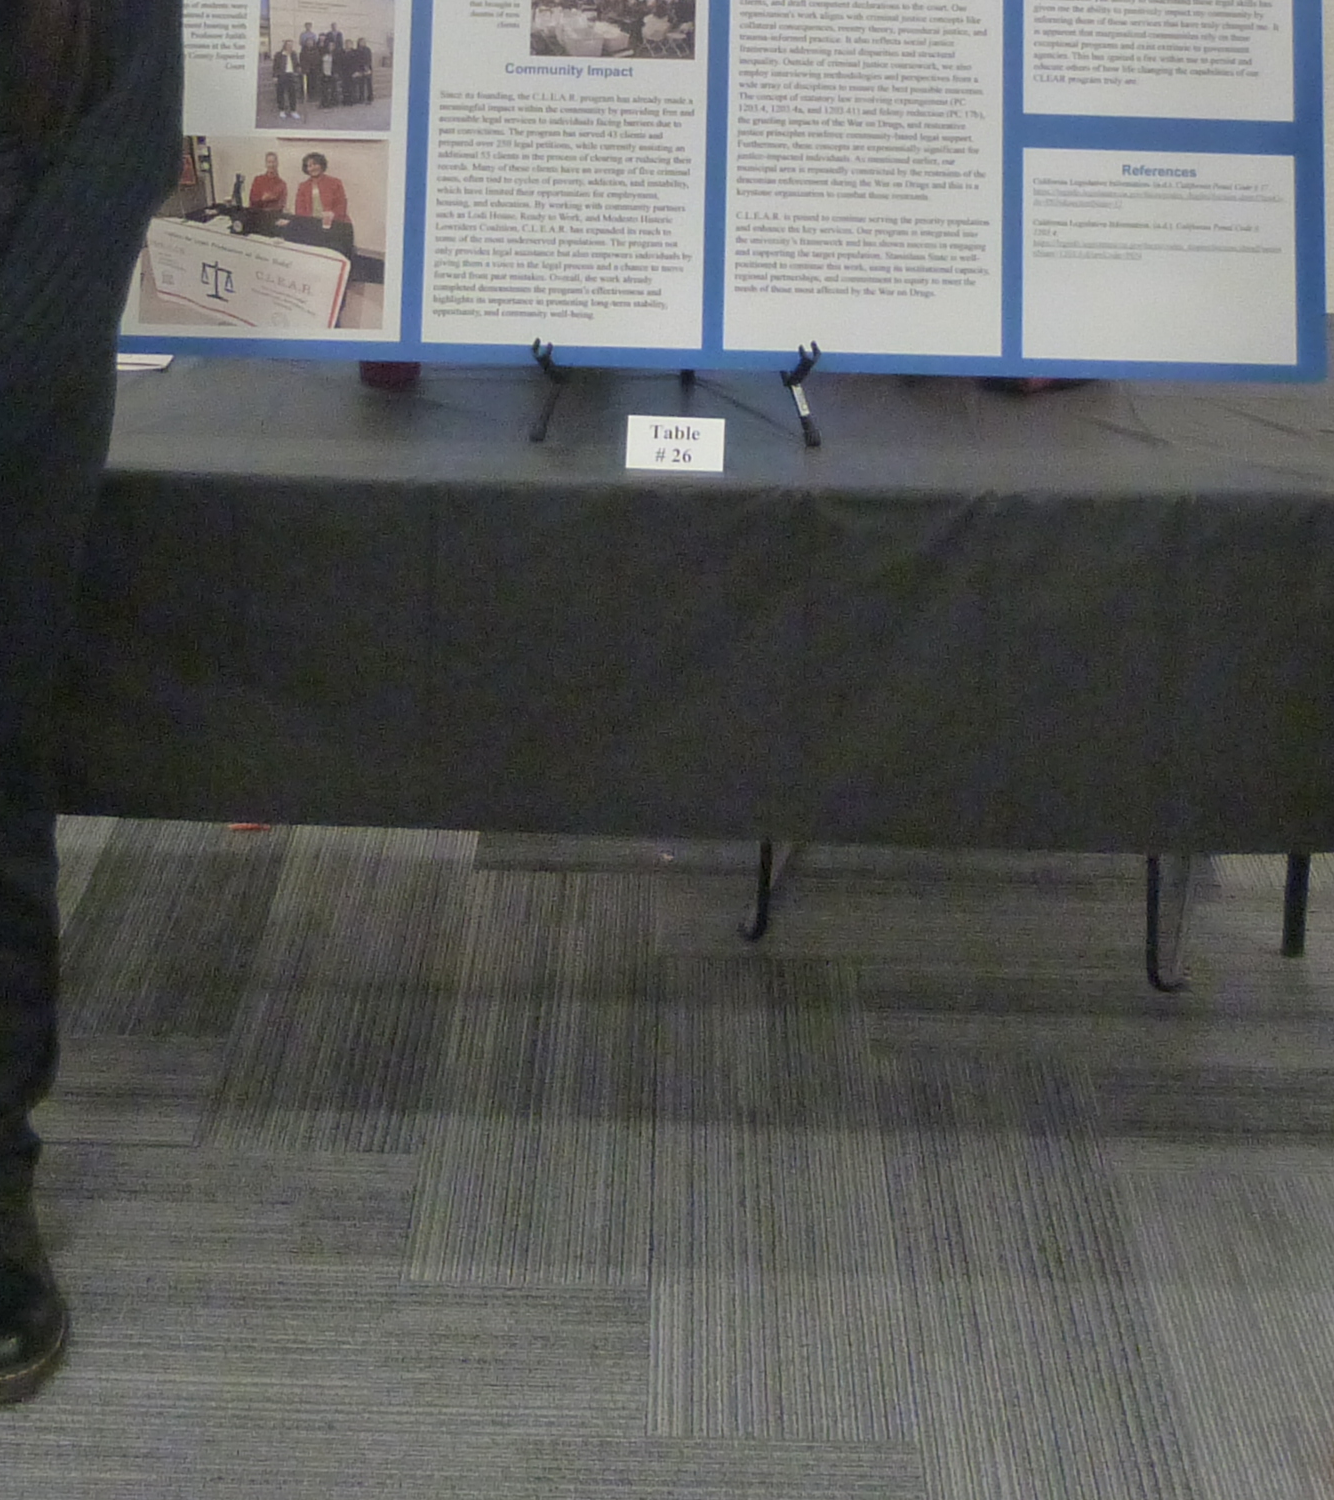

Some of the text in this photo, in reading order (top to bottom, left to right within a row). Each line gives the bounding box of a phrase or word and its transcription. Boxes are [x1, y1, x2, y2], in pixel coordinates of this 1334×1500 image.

[505, 63, 634, 80] Community Impact
[1122, 165, 1197, 178] References
[650, 424, 701, 441] Table
[655, 448, 692, 463] # 26
